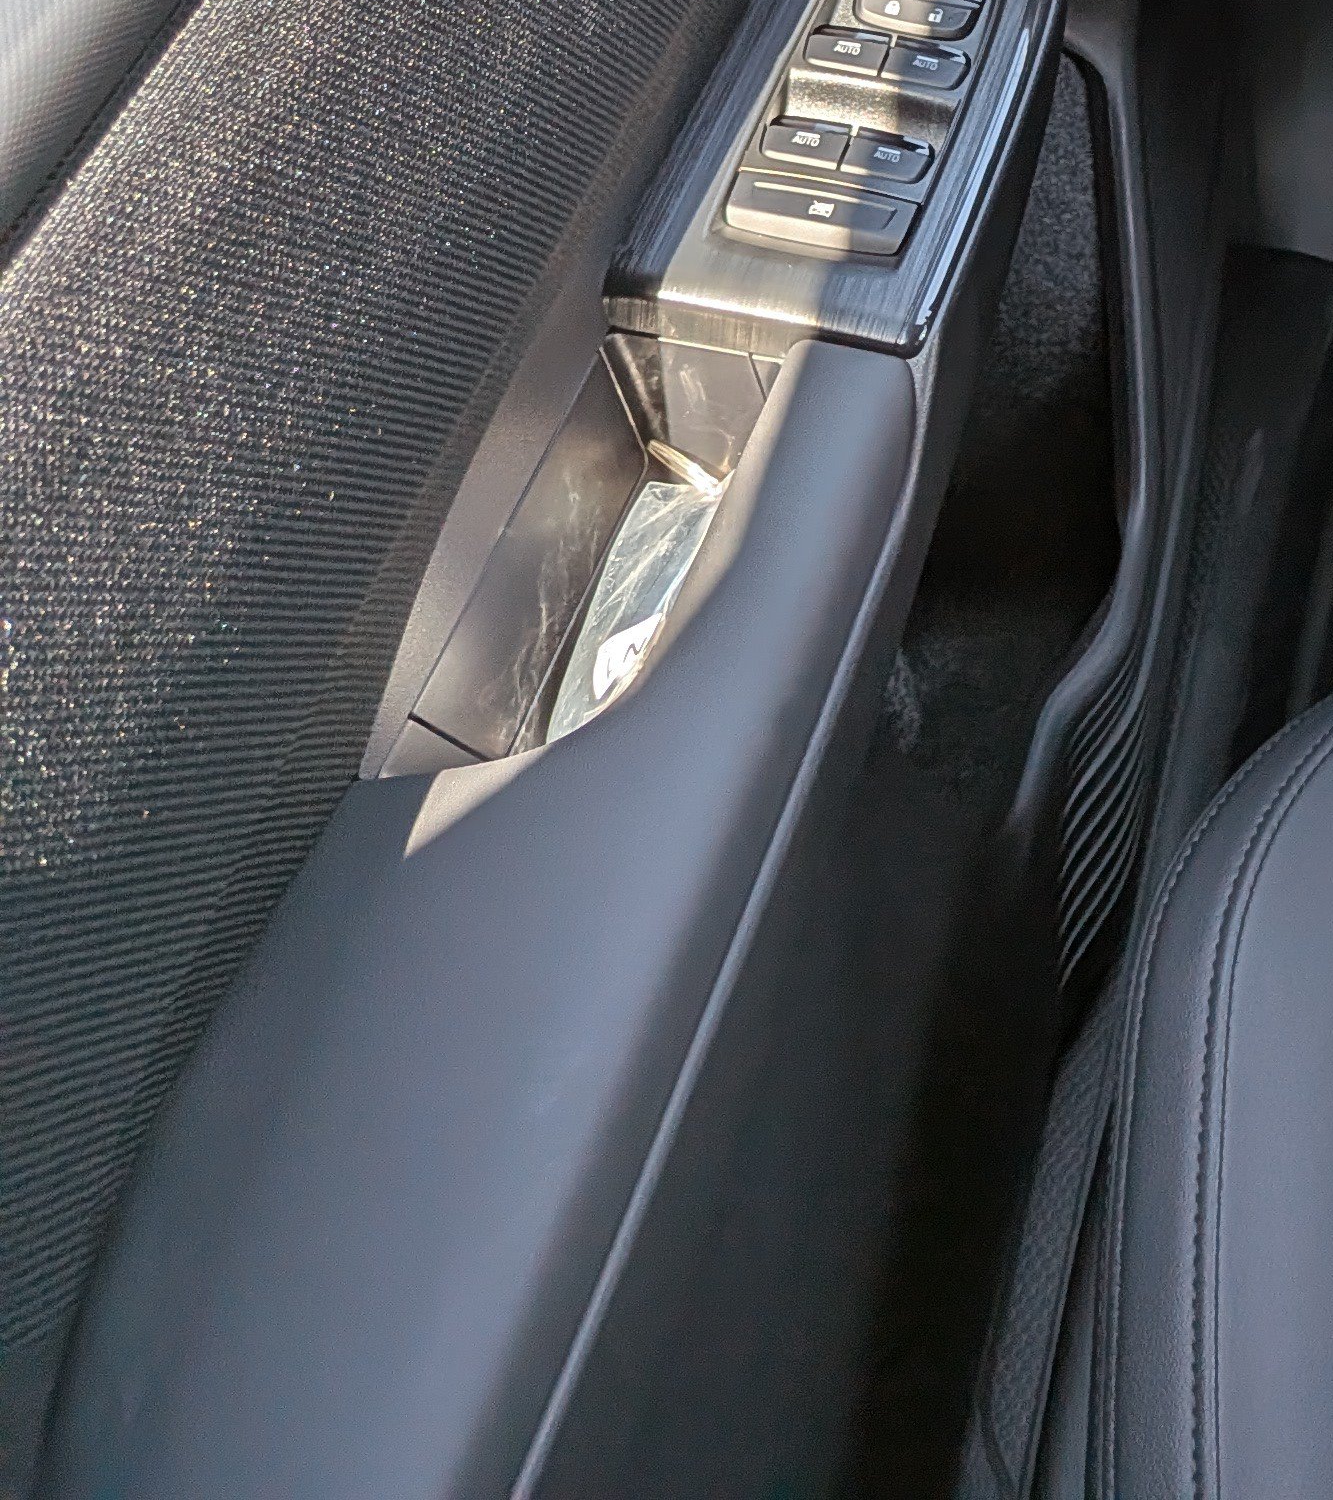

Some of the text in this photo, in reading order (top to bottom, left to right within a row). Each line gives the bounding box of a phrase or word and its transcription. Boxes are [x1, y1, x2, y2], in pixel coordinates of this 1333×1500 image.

[834, 44, 861, 56] AUTO
[912, 58, 938, 72] AUTO
[792, 135, 820, 147] AUTO
[874, 149, 900, 163] AUTO
